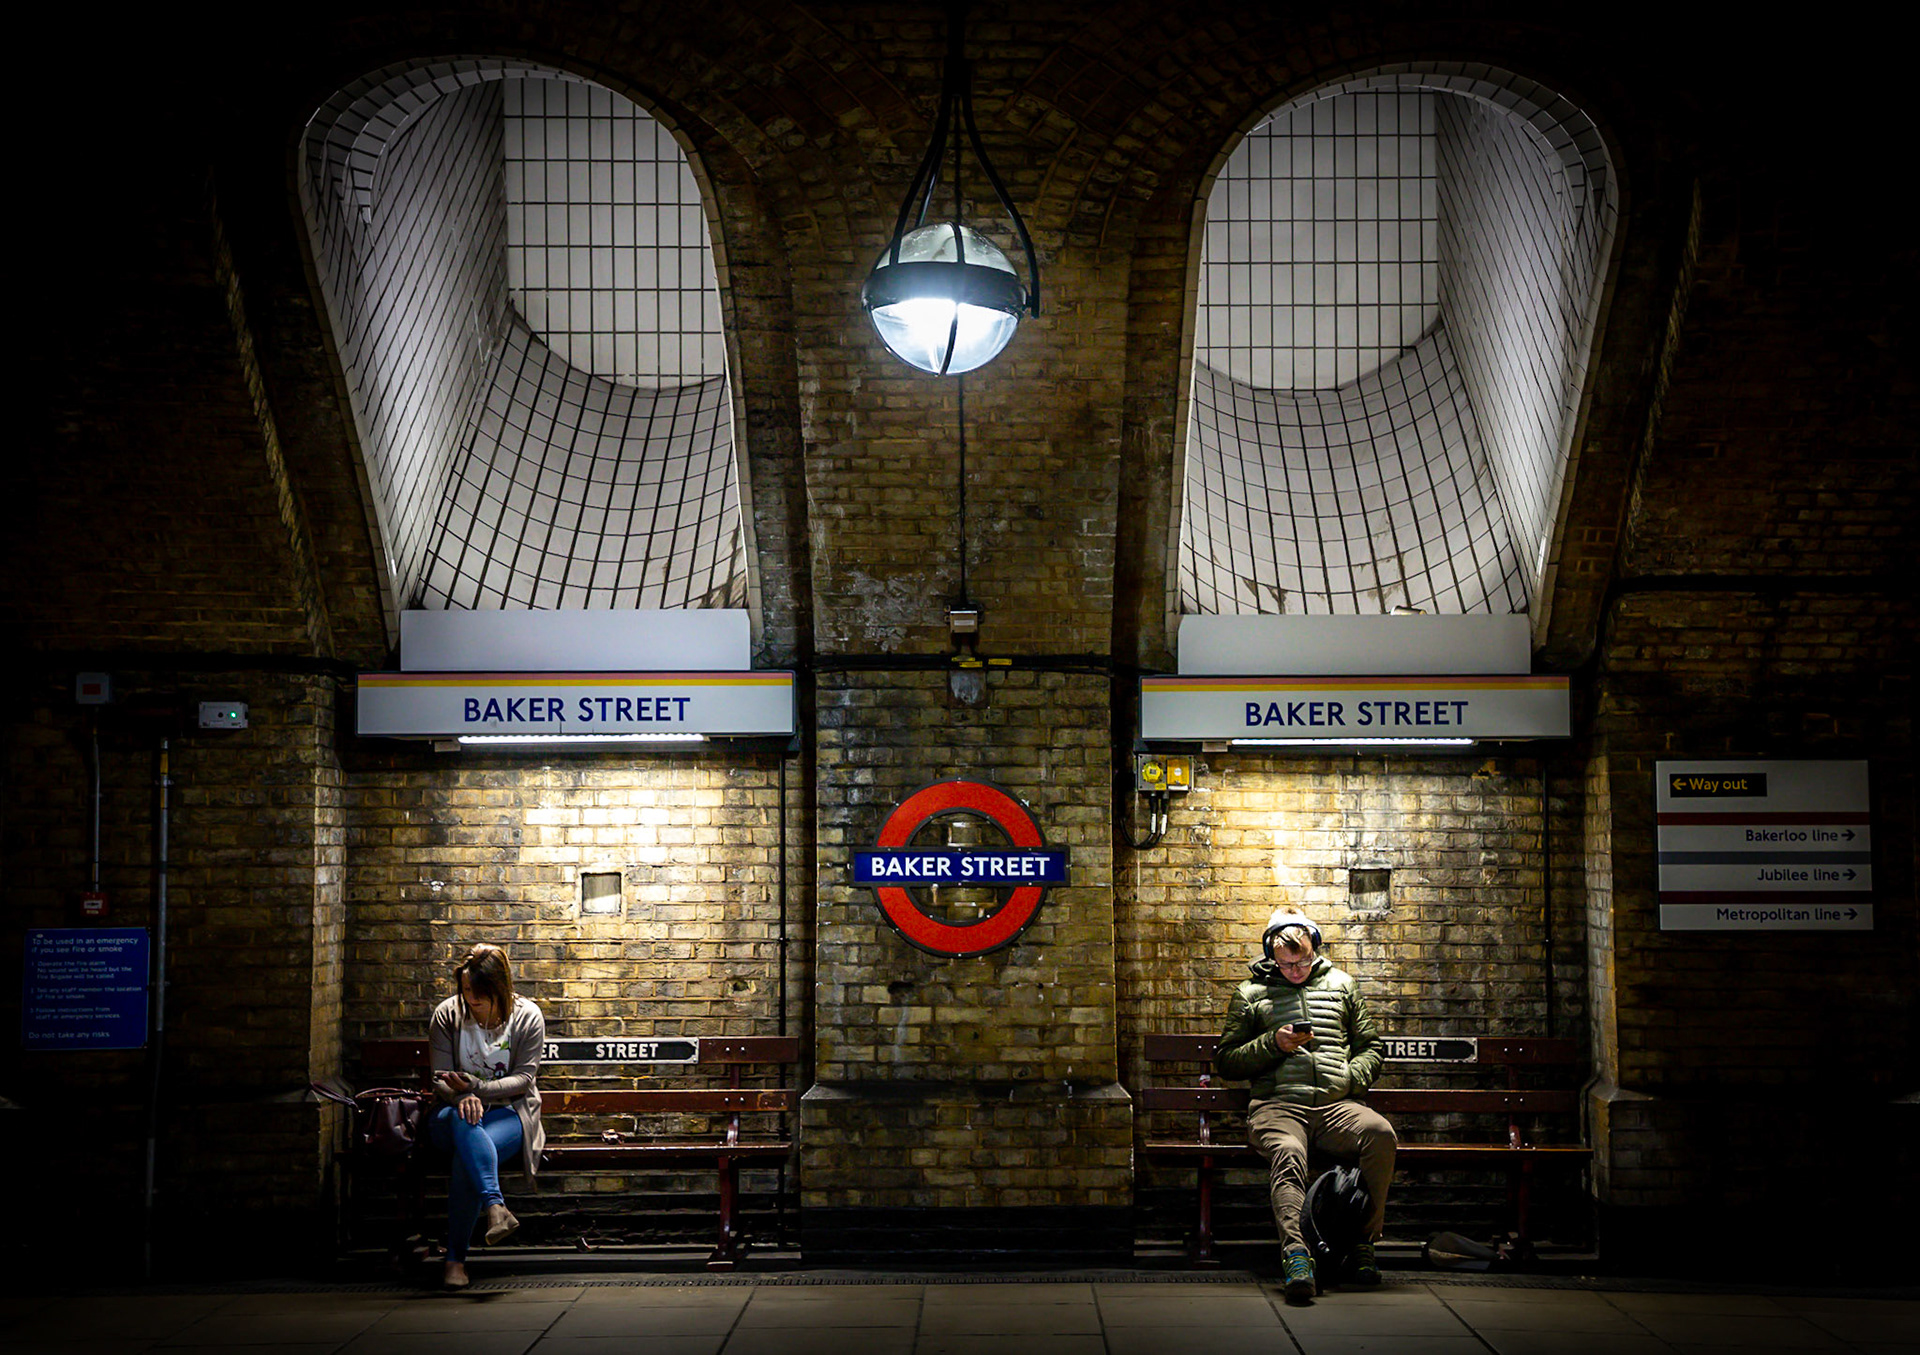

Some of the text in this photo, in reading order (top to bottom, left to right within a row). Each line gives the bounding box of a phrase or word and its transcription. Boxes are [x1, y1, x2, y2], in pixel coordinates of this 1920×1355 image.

[464, 697, 691, 722] BAKER STREET
[1246, 701, 1469, 726] BAKER STREET
[1688, 778, 1749, 793] Way out
[1746, 829, 1838, 842] Bakerloo line
[871, 856, 1051, 877] BAKER STREET
[1757, 868, 1840, 881] Jubilee line
[1717, 907, 1841, 923] Metropolitan line
[595, 1044, 659, 1058] STREET
[1384, 1041, 1437, 1056] TREET
